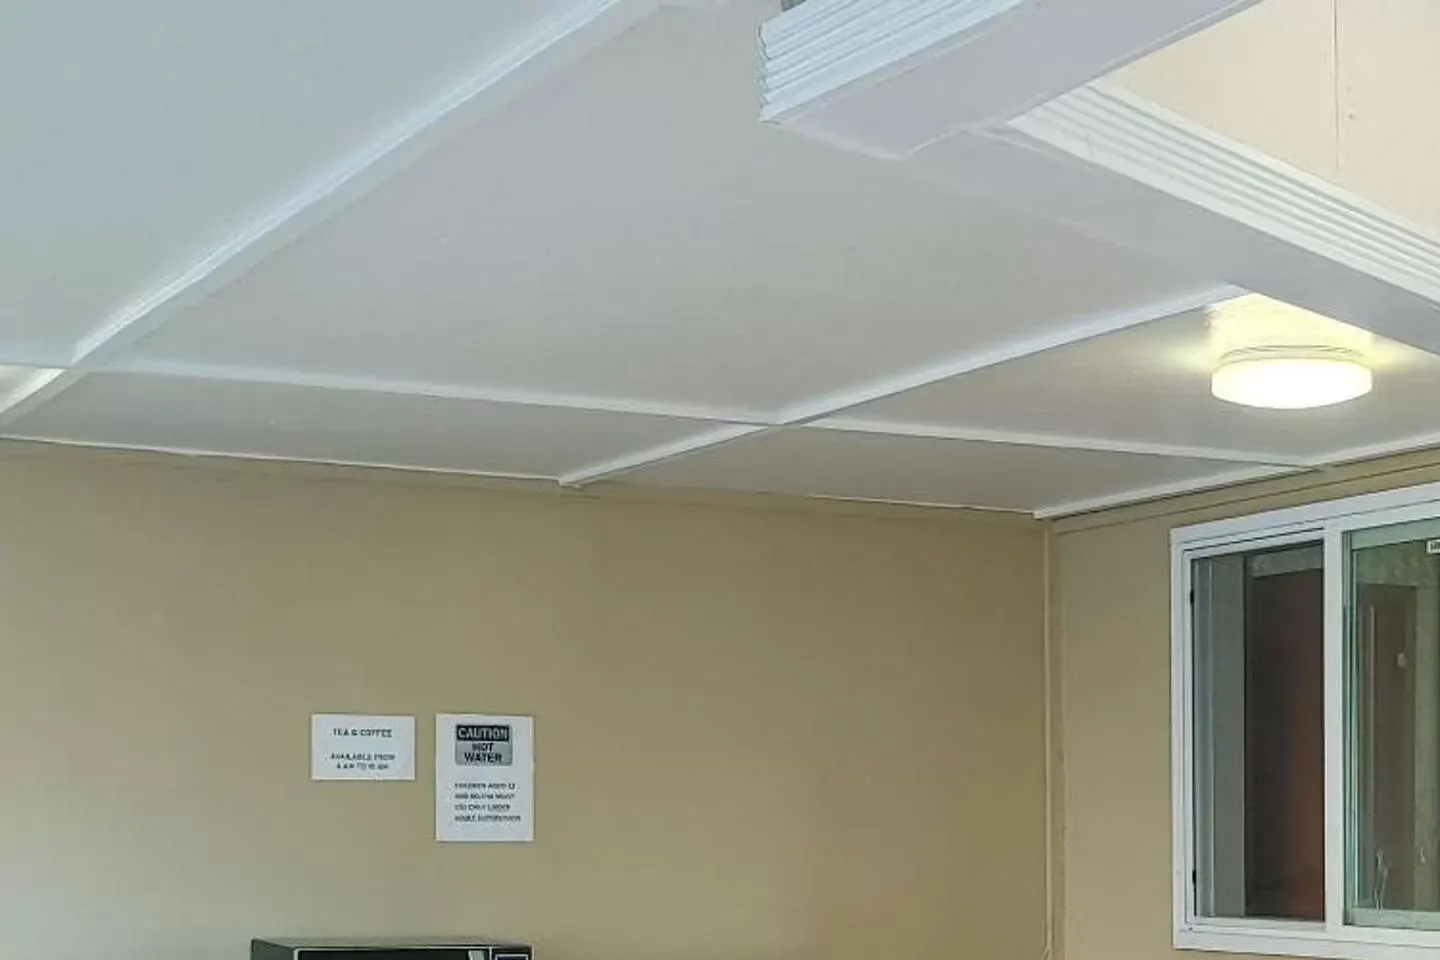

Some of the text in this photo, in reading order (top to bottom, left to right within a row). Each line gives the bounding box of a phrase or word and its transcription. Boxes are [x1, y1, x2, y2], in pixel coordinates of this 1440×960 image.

[333, 728, 349, 736] TEA
[360, 729, 392, 738] COFFEE
[458, 727, 508, 740] CAUTION
[472, 743, 494, 751] HOT
[464, 753, 502, 763] WATER
